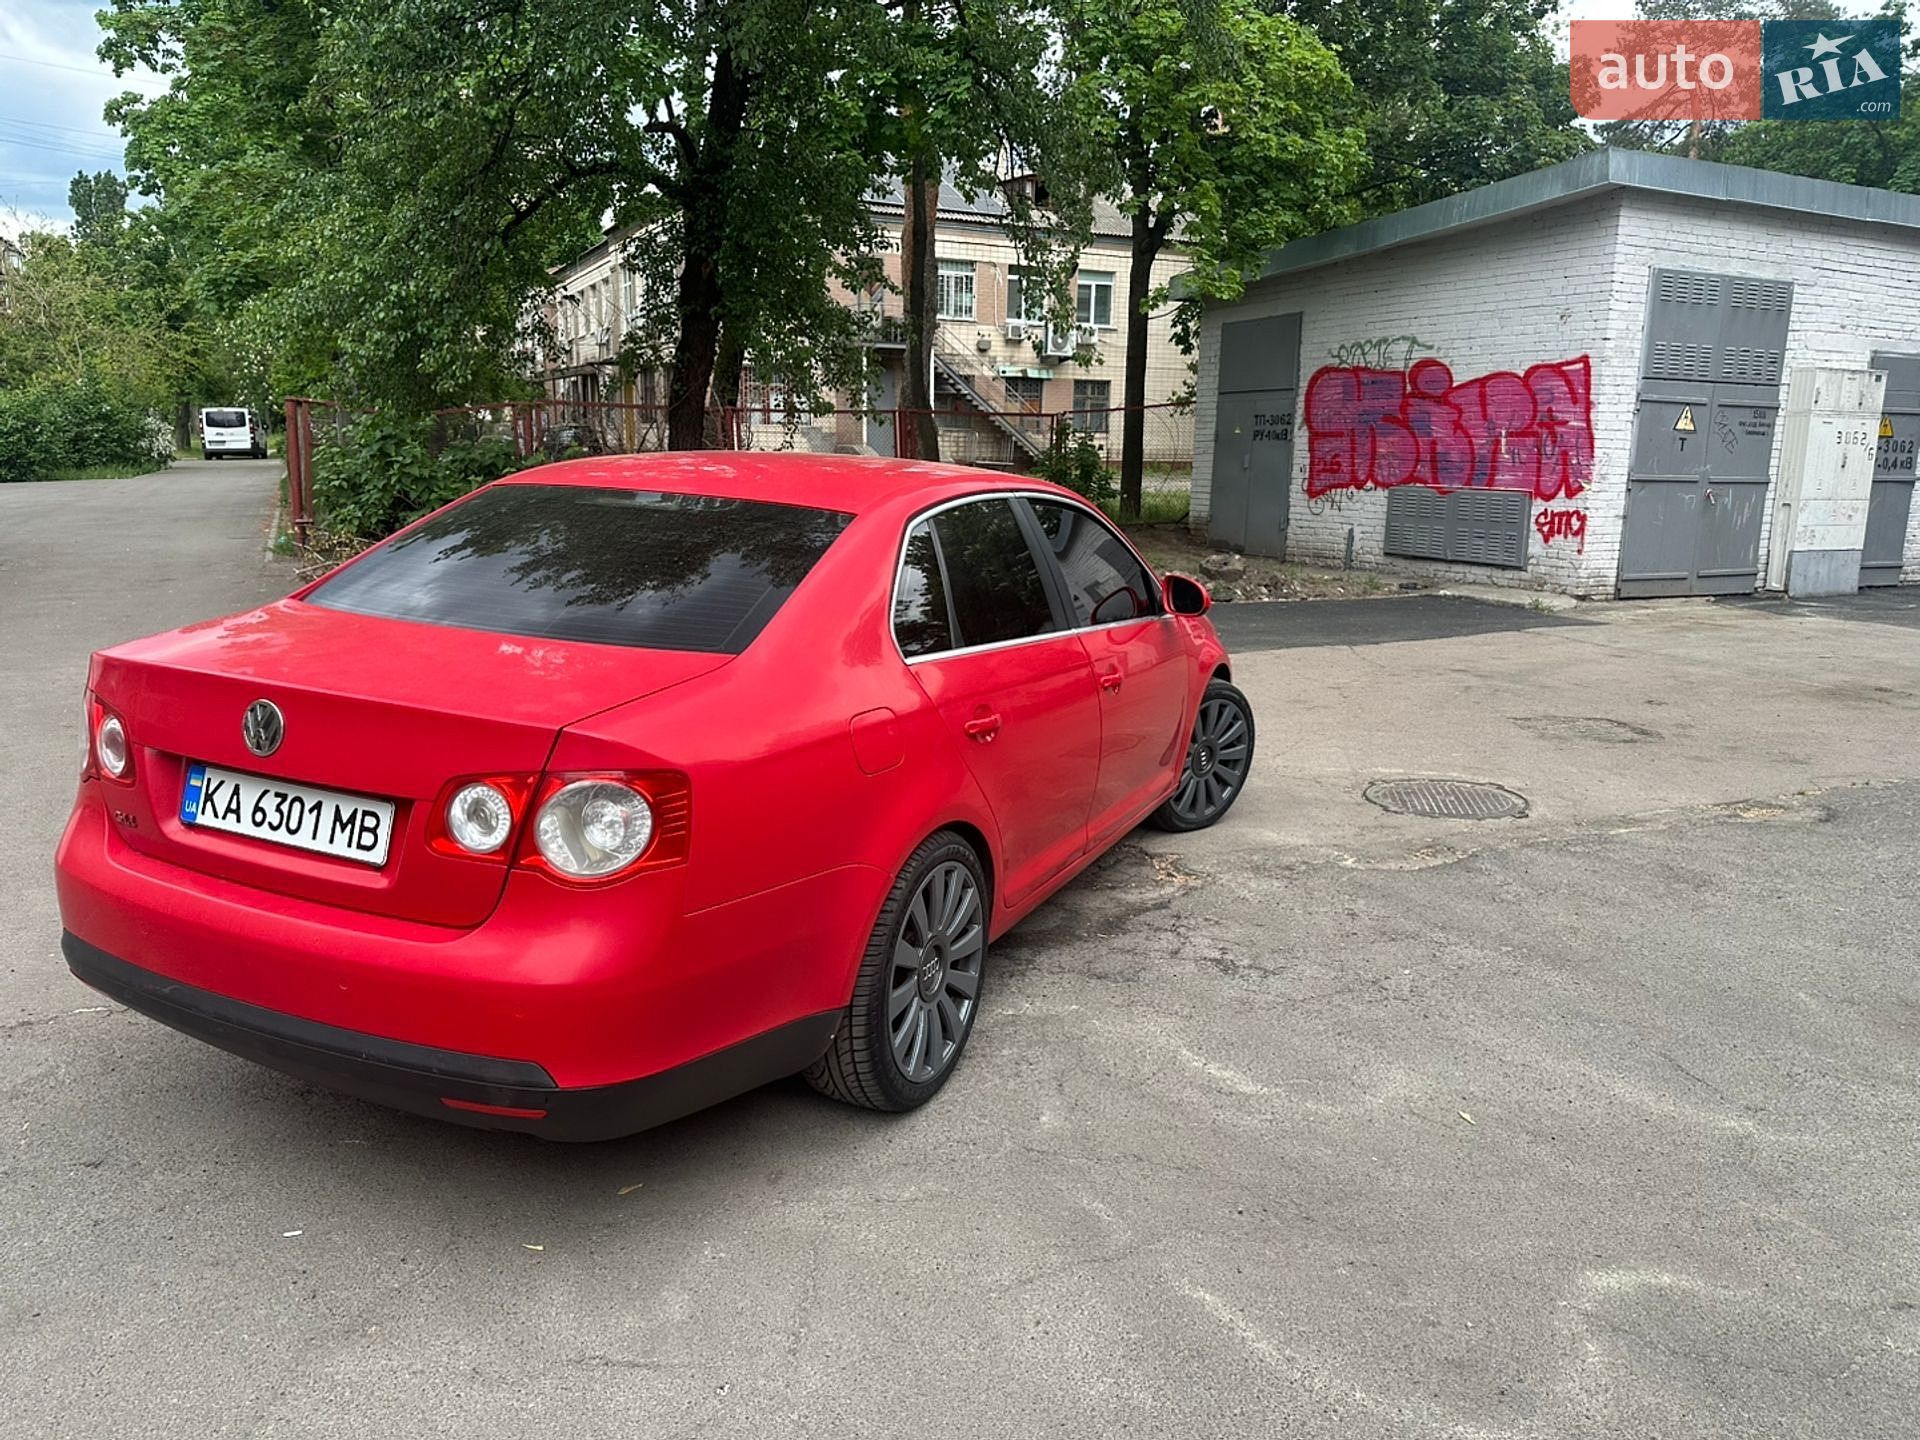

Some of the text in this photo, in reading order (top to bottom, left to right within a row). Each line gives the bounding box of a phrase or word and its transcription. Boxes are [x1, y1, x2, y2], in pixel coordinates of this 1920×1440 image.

[1878, 440, 1915, 454] -3062
[184, 800, 197, 814] UA
[201, 777, 381, 852] KA 6301 MB
